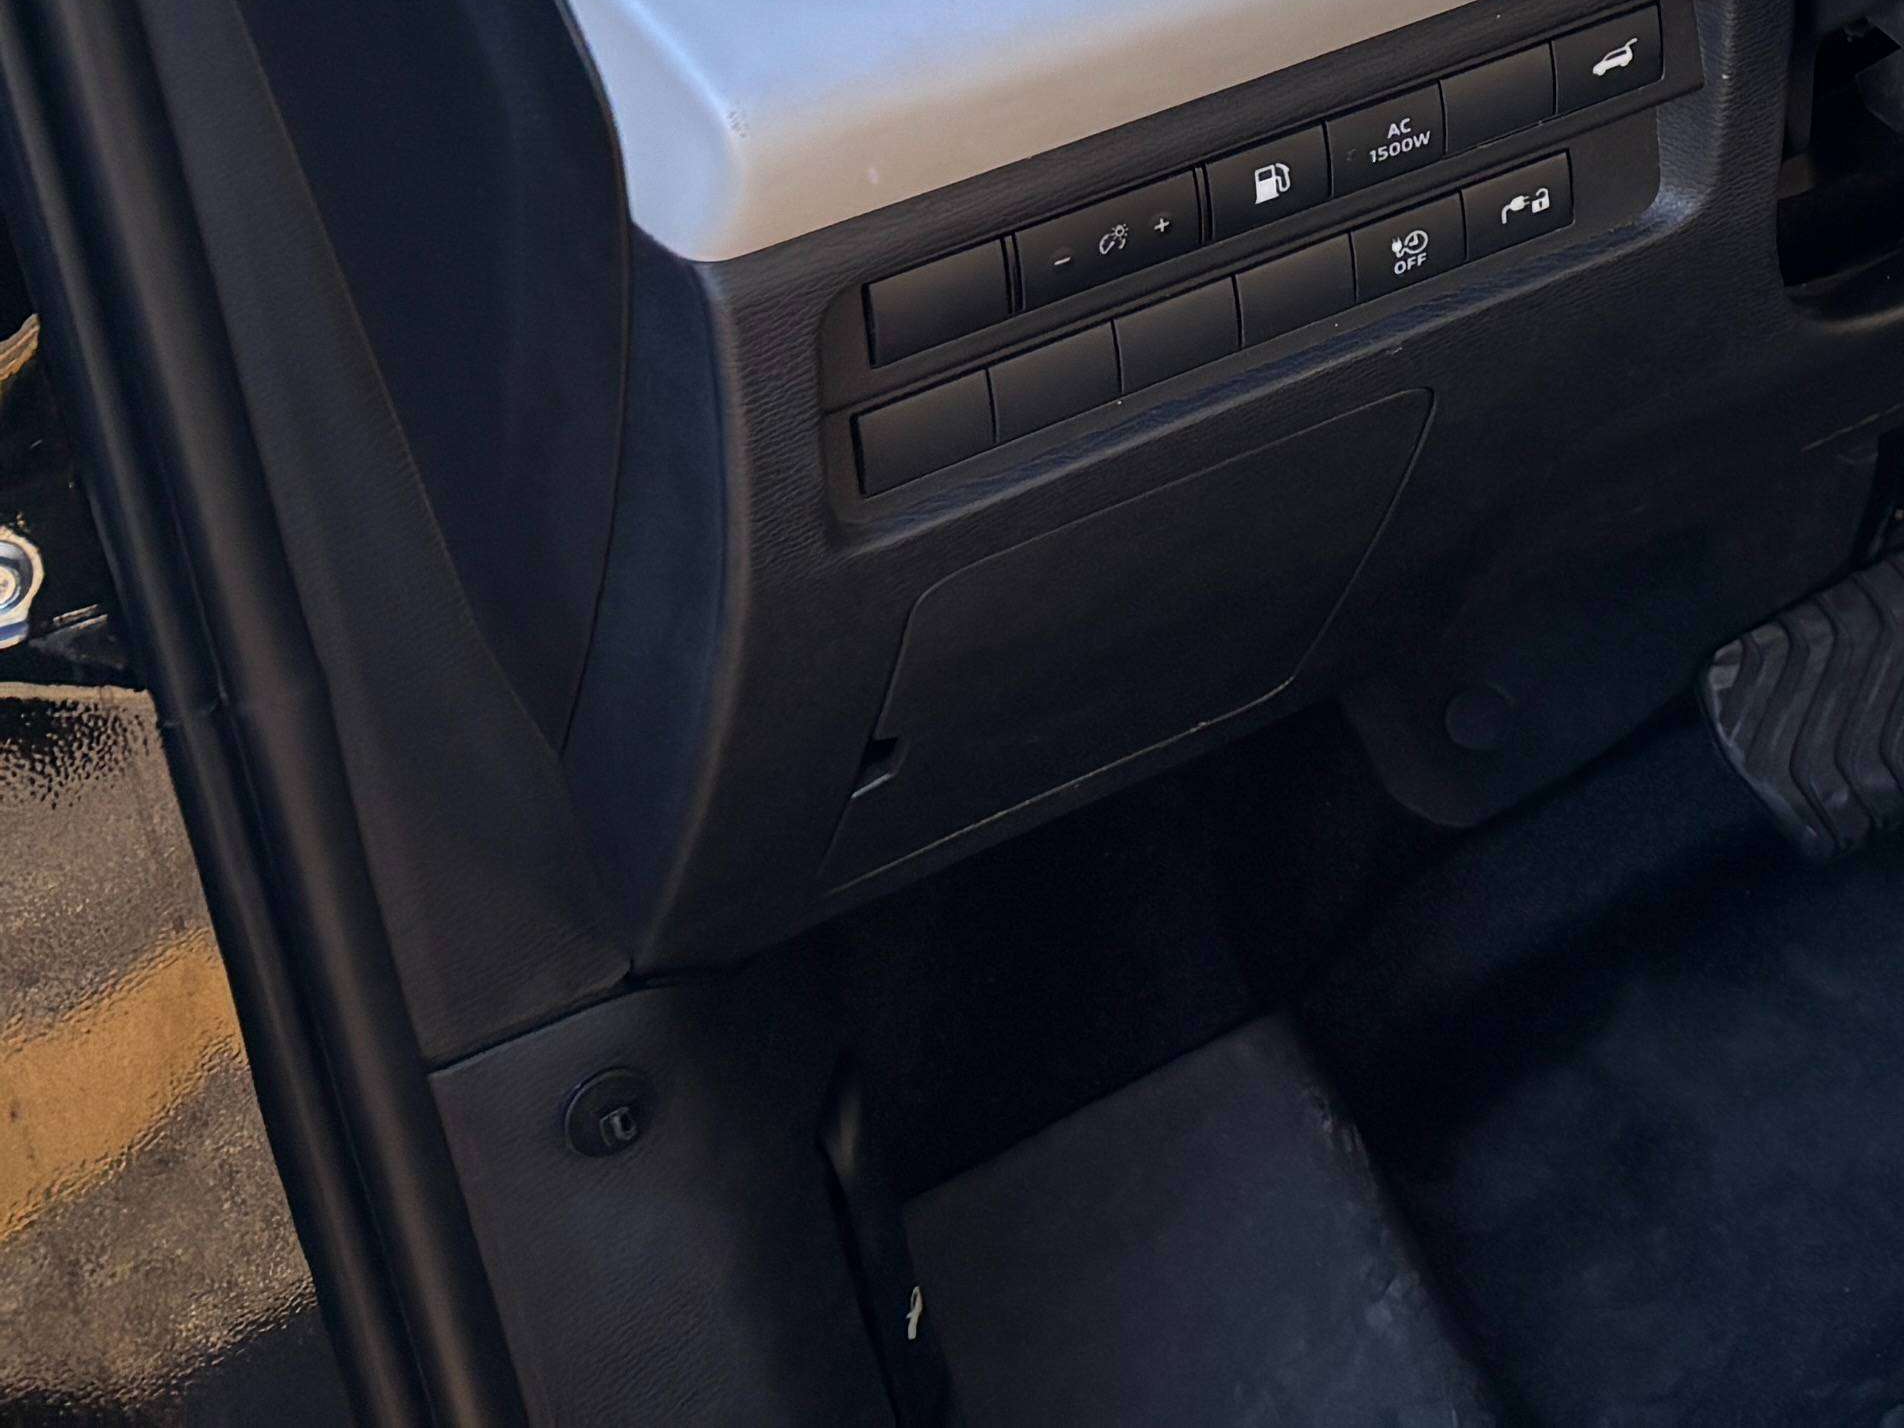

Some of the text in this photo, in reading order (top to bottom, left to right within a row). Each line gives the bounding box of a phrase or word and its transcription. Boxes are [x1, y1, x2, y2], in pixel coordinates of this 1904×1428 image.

[1387, 117, 1412, 140] AC
[1369, 130, 1431, 164] 1500W
[1394, 251, 1428, 276] OFF
